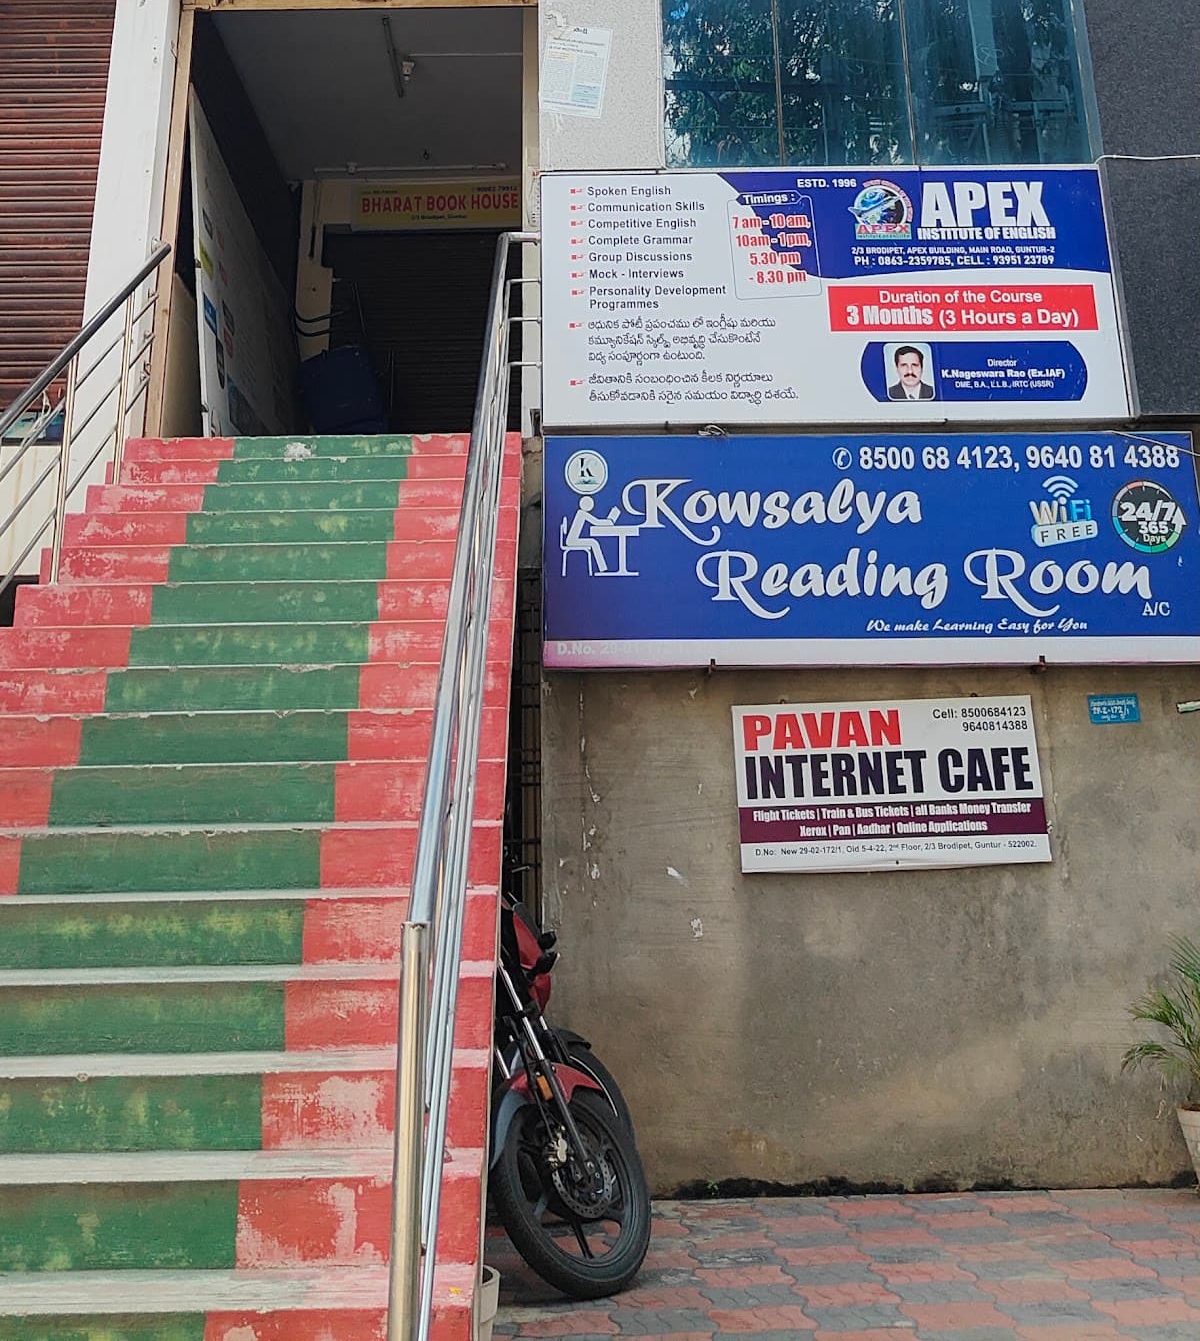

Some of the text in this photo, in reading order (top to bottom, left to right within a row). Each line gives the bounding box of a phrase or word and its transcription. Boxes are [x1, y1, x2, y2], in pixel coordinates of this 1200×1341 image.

[796, 178, 857, 188] ESTD. 1996
[587, 185, 671, 198] Spoken English
[361, 193, 518, 214] BHARAT BOOK HOUSE
[587, 201, 705, 212] Communication Skills
[743, 194, 788, 205] Timings
[920, 181, 1050, 228] APEX
[588, 218, 697, 230] Competitive English
[732, 216, 740, 229] 7
[742, 218, 761, 228] am
[770, 215, 785, 228] 10
[858, 224, 909, 234] APEX
[917, 227, 983, 240] INSTITUTE
[984, 227, 1000, 240] OF
[1002, 226, 1056, 240] ENGLISH
[588, 235, 694, 247] Complete Grammar
[851, 246, 865, 255] 2/3
[907, 246, 928, 255] APEX
[969, 246, 989, 254] MAIN
[1015, 245, 1055, 254] GUNTUR-2
[588, 251, 693, 264] Group Discussions
[749, 252, 801, 266] 5.30 pm
[854, 256, 870, 266] PH
[957, 255, 986, 266] CELL
[992, 255, 1021, 265] 93951
[1024, 255, 1055, 265] 23789
[589, 268, 684, 279] Mock Interviews
[756, 270, 807, 284] 8.30 pm
[589, 285, 727, 298] Personality Development
[879, 289, 1043, 304] Duration of the Course
[589, 299, 660, 311] Programmes
[847, 305, 1079, 329] 3 Months (3 Hours a Day)
[987, 358, 1018, 367] Director
[941, 368, 1005, 379] K.Nageswara
[1006, 368, 1026, 378] Rao
[859, 444, 1180, 473] 8500 68 4123, 9640 81 4388
[621, 477, 923, 547] Kowsalya
[1029, 496, 1092, 526] WiFi
[1119, 499, 1176, 522] 24/7
[1040, 524, 1094, 543] FREE
[1137, 521, 1169, 535] 365
[1143, 533, 1168, 544] Days
[696, 547, 1153, 621] Reading Room
[1142, 601, 1171, 617] A/C
[866, 617, 1088, 634] We make Learning Easy for You
[932, 706, 1027, 719] Cell: 8500684123
[741, 708, 902, 752] PAVAN
[962, 720, 1028, 732] 9640814388
[744, 746, 1034, 800] INTERNET CAFE
[753, 810, 780, 823] Flight
[780, 809, 815, 821] Tickets
[821, 807, 846, 820] Train
[855, 807, 874, 818] Bus
[875, 805, 910, 818] Tickets
[929, 804, 958, 816] Banks
[959, 802, 991, 816] Money
[991, 801, 1031, 814] Transfer
[799, 819, 988, 837] Xerox Pan Aadhar Online Applications
[781, 847, 798, 856] New
[924, 841, 936, 851] 2/3
[974, 841, 1001, 850] Guntur
